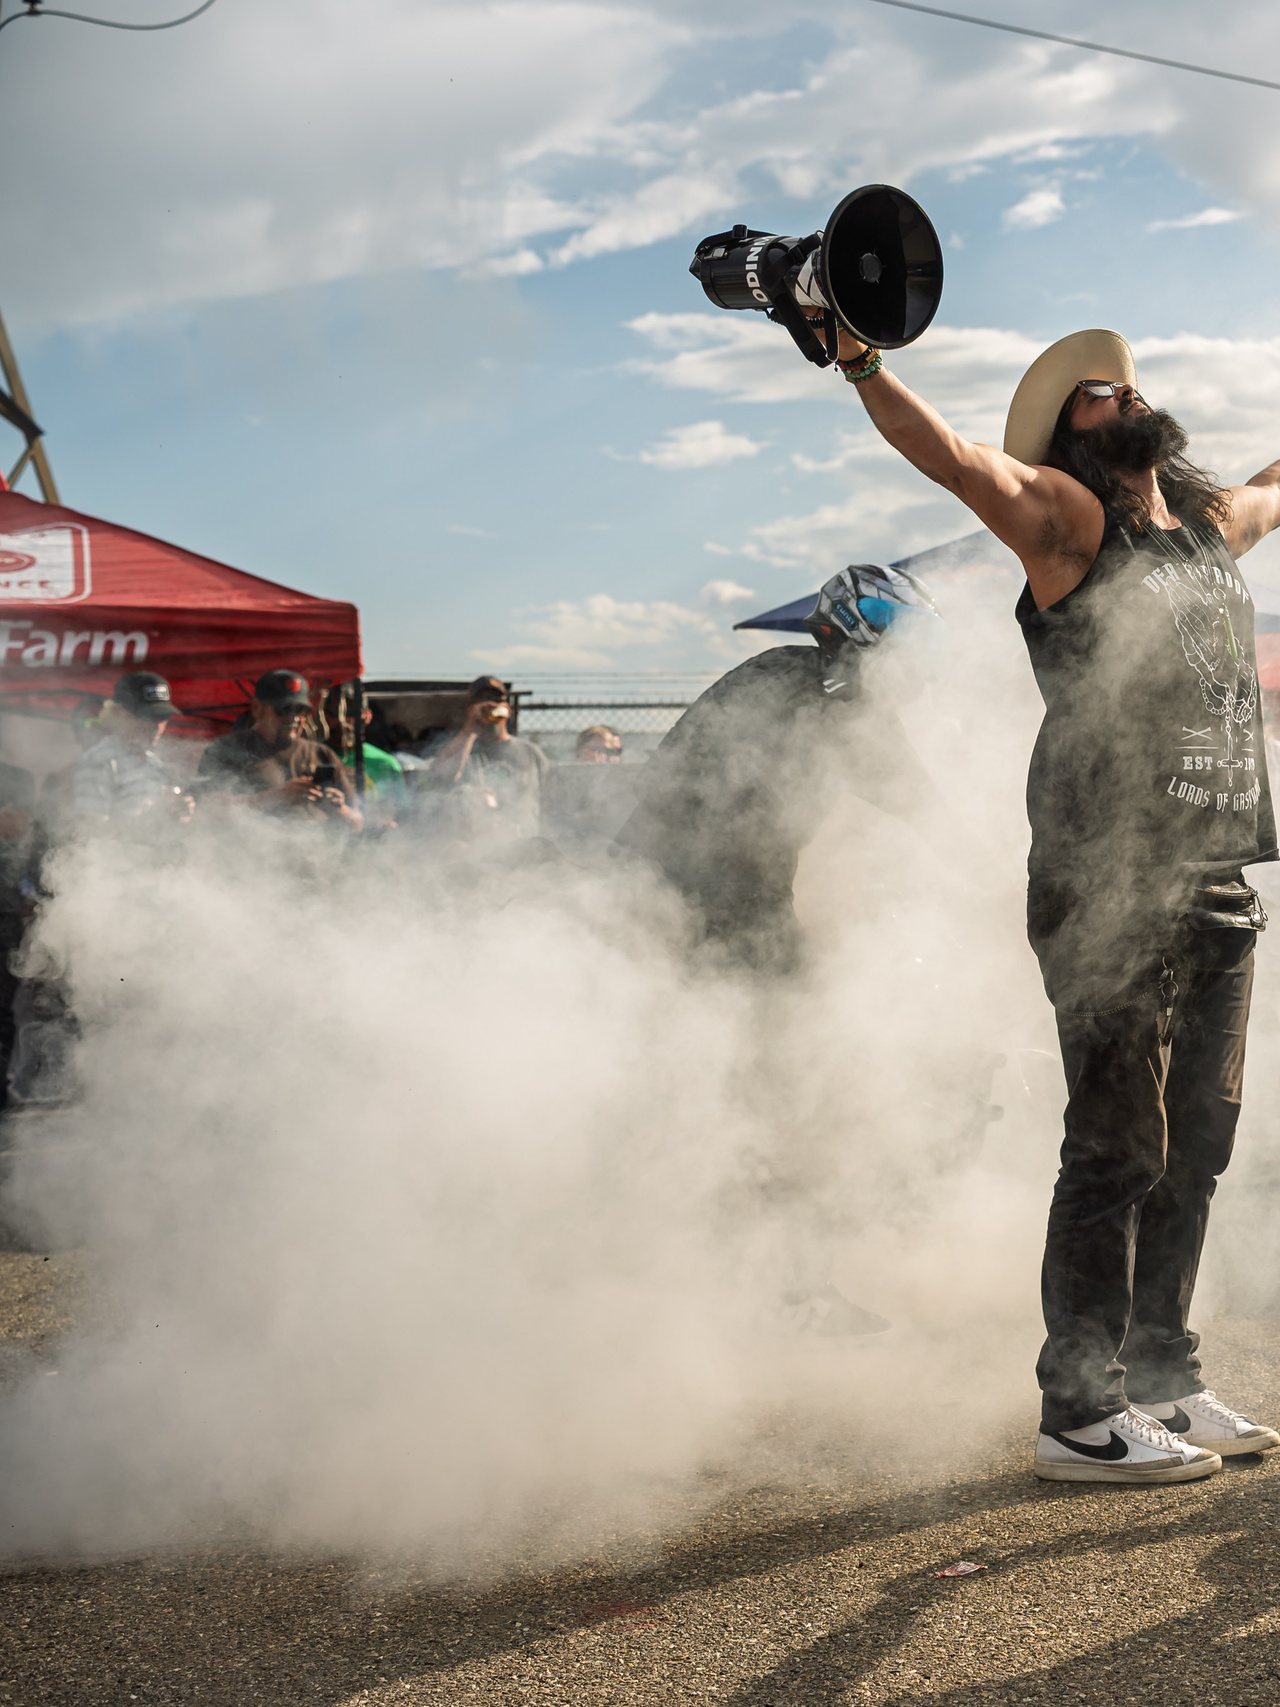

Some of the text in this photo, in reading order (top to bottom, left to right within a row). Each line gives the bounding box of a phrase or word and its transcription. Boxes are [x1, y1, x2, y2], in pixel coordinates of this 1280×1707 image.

[1183, 756, 1213, 770] EST
[1167, 776, 1211, 808] LORDS
[1216, 792, 1229, 813] OF
